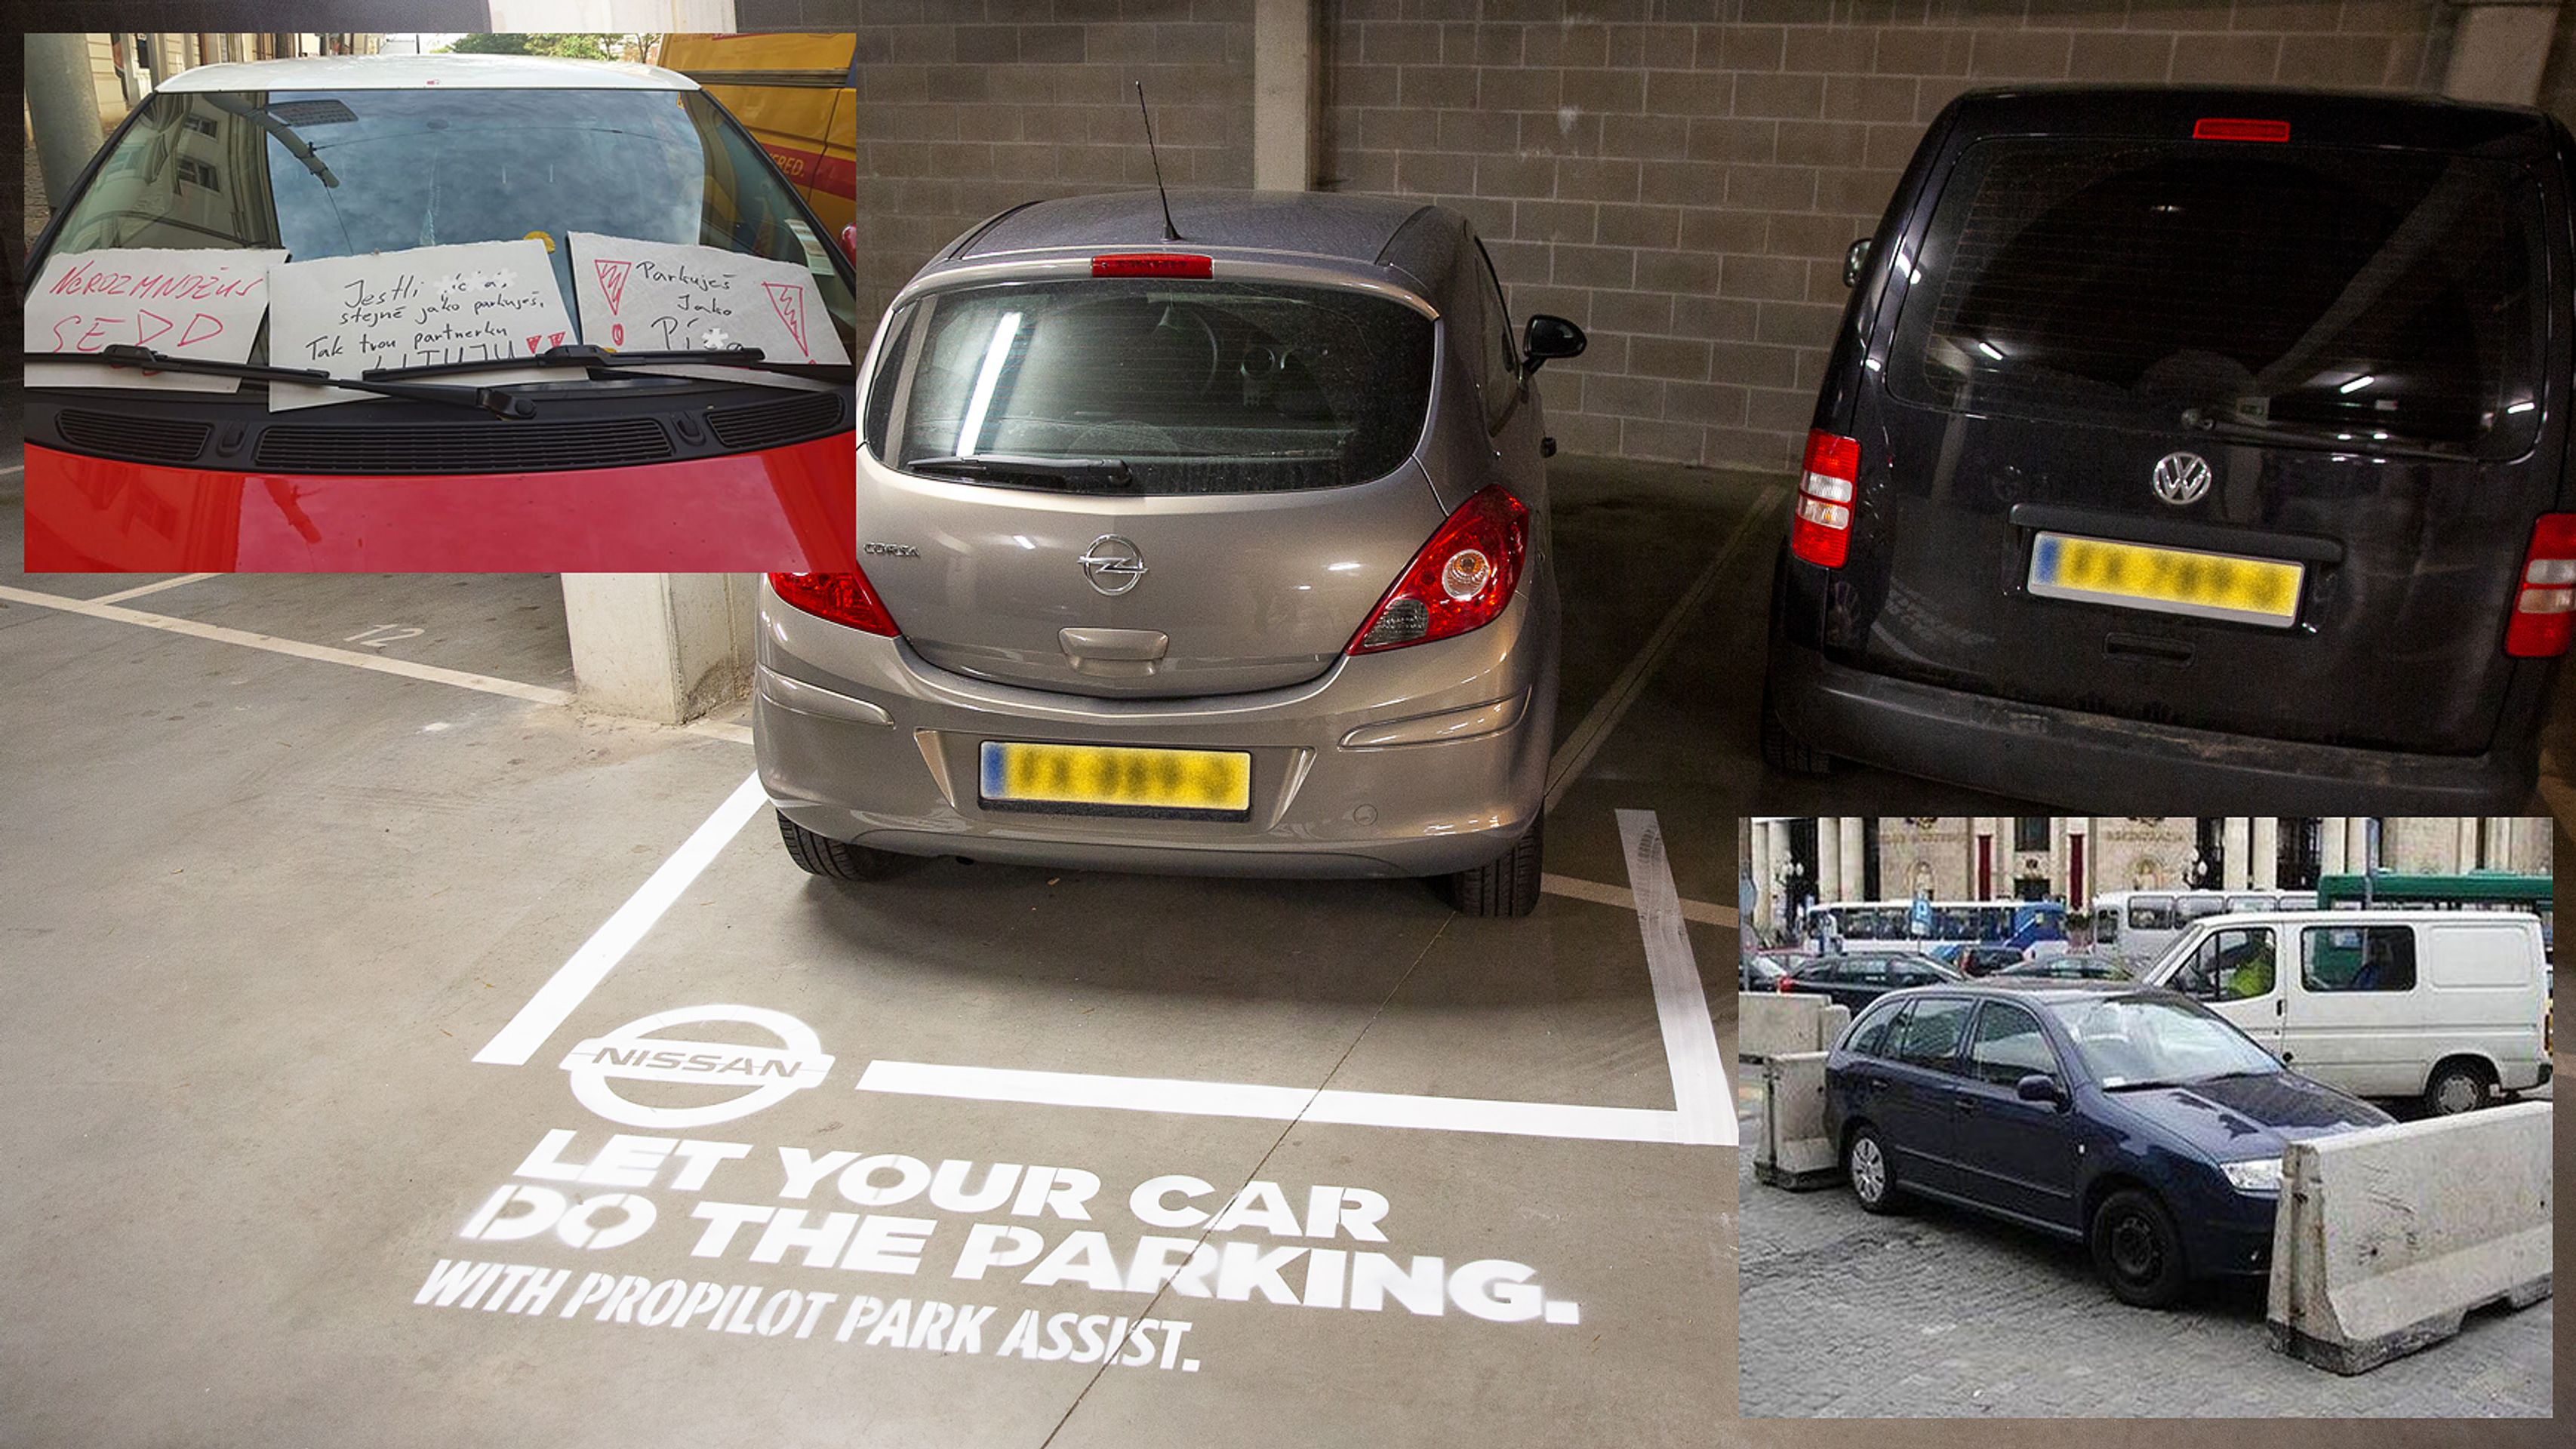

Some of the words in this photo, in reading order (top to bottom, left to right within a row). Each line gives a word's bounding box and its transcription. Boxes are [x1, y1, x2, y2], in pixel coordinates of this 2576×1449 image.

[344, 275, 423, 306] Jestli
[306, 335, 343, 361] Tak
[863, 541, 921, 557] CORSA
[343, 623, 425, 648] 12
[592, 1046, 803, 1079] NISSAN
[511, 1128, 755, 1192] LET
[777, 1146, 1101, 1221] YOUR
[1128, 1174, 1390, 1243] CAR
[457, 1183, 658, 1251] DO
[689, 1201, 938, 1275] THE
[951, 1223, 1581, 1325] PARKING.
[412, 1258, 574, 1316] WITH
[559, 1271, 839, 1341] PROPILOT
[834, 1294, 999, 1355] PARK
[996, 1308, 1202, 1373] ASSIST.
